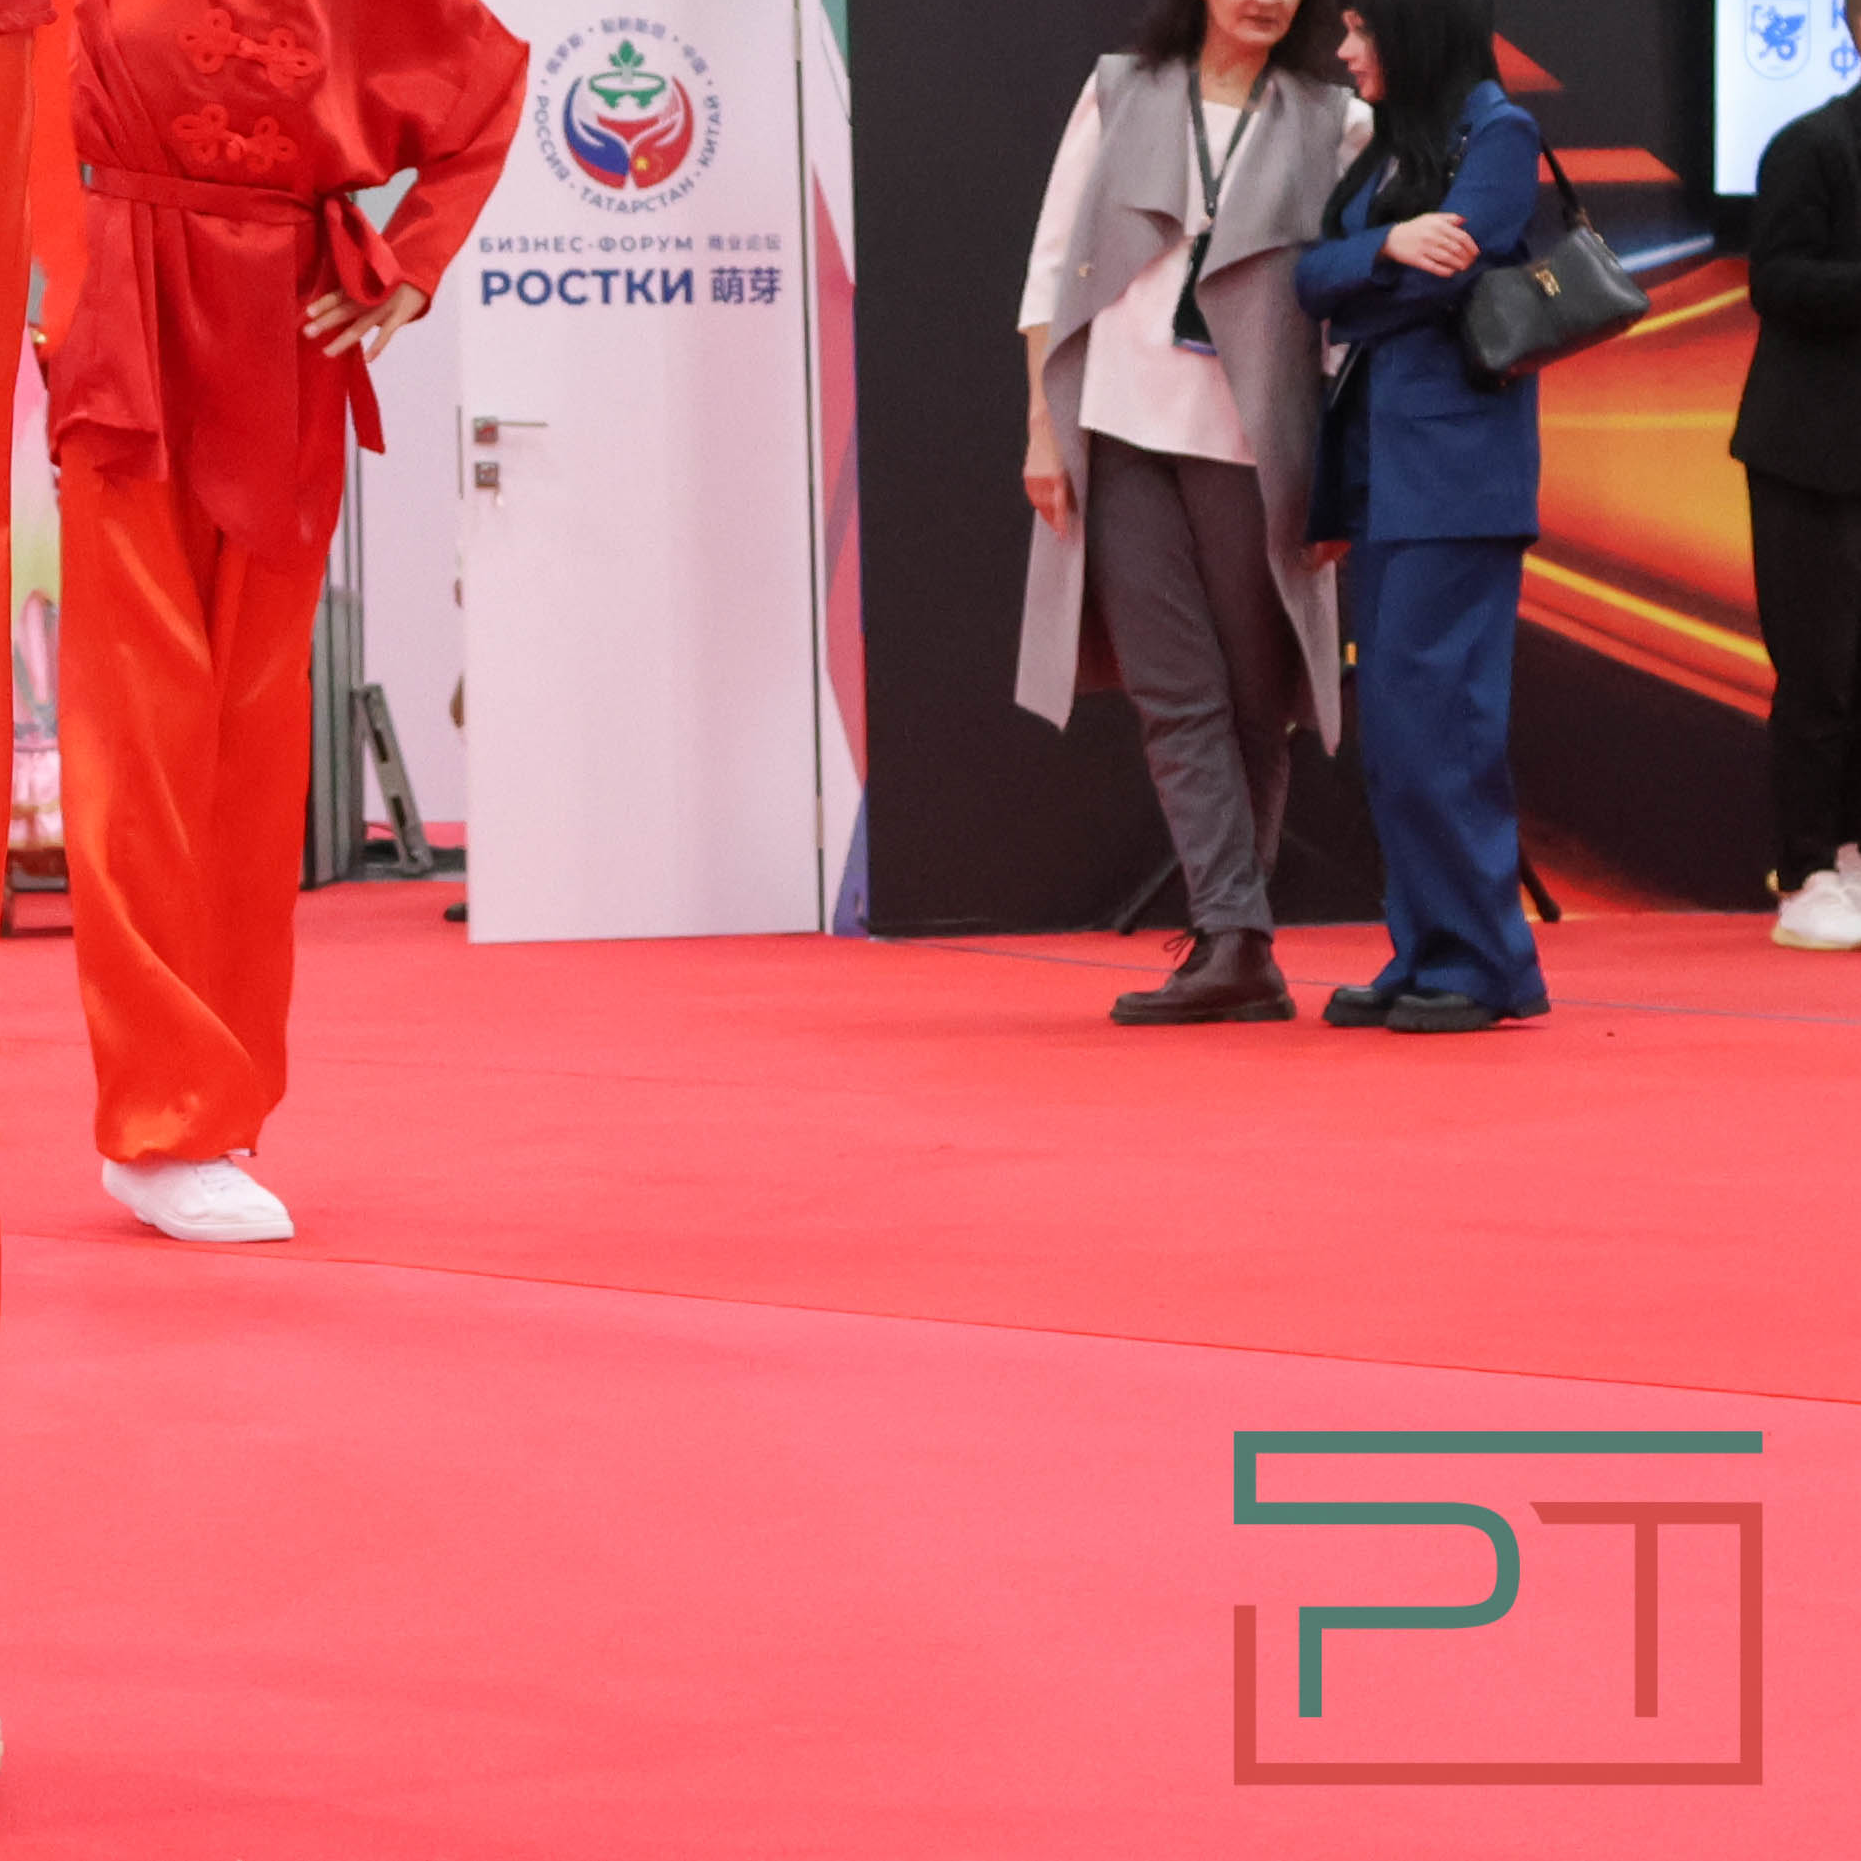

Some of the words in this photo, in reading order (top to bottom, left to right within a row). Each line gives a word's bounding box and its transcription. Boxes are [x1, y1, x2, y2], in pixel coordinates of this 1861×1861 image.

[534, 94, 571, 181] РОССИЯ
[580, 177, 694, 213] ТАТАРСТАН
[480, 236, 693, 253] БИЗНЕС-ФОРУМ
[482, 268, 694, 306] РОСТКИ
